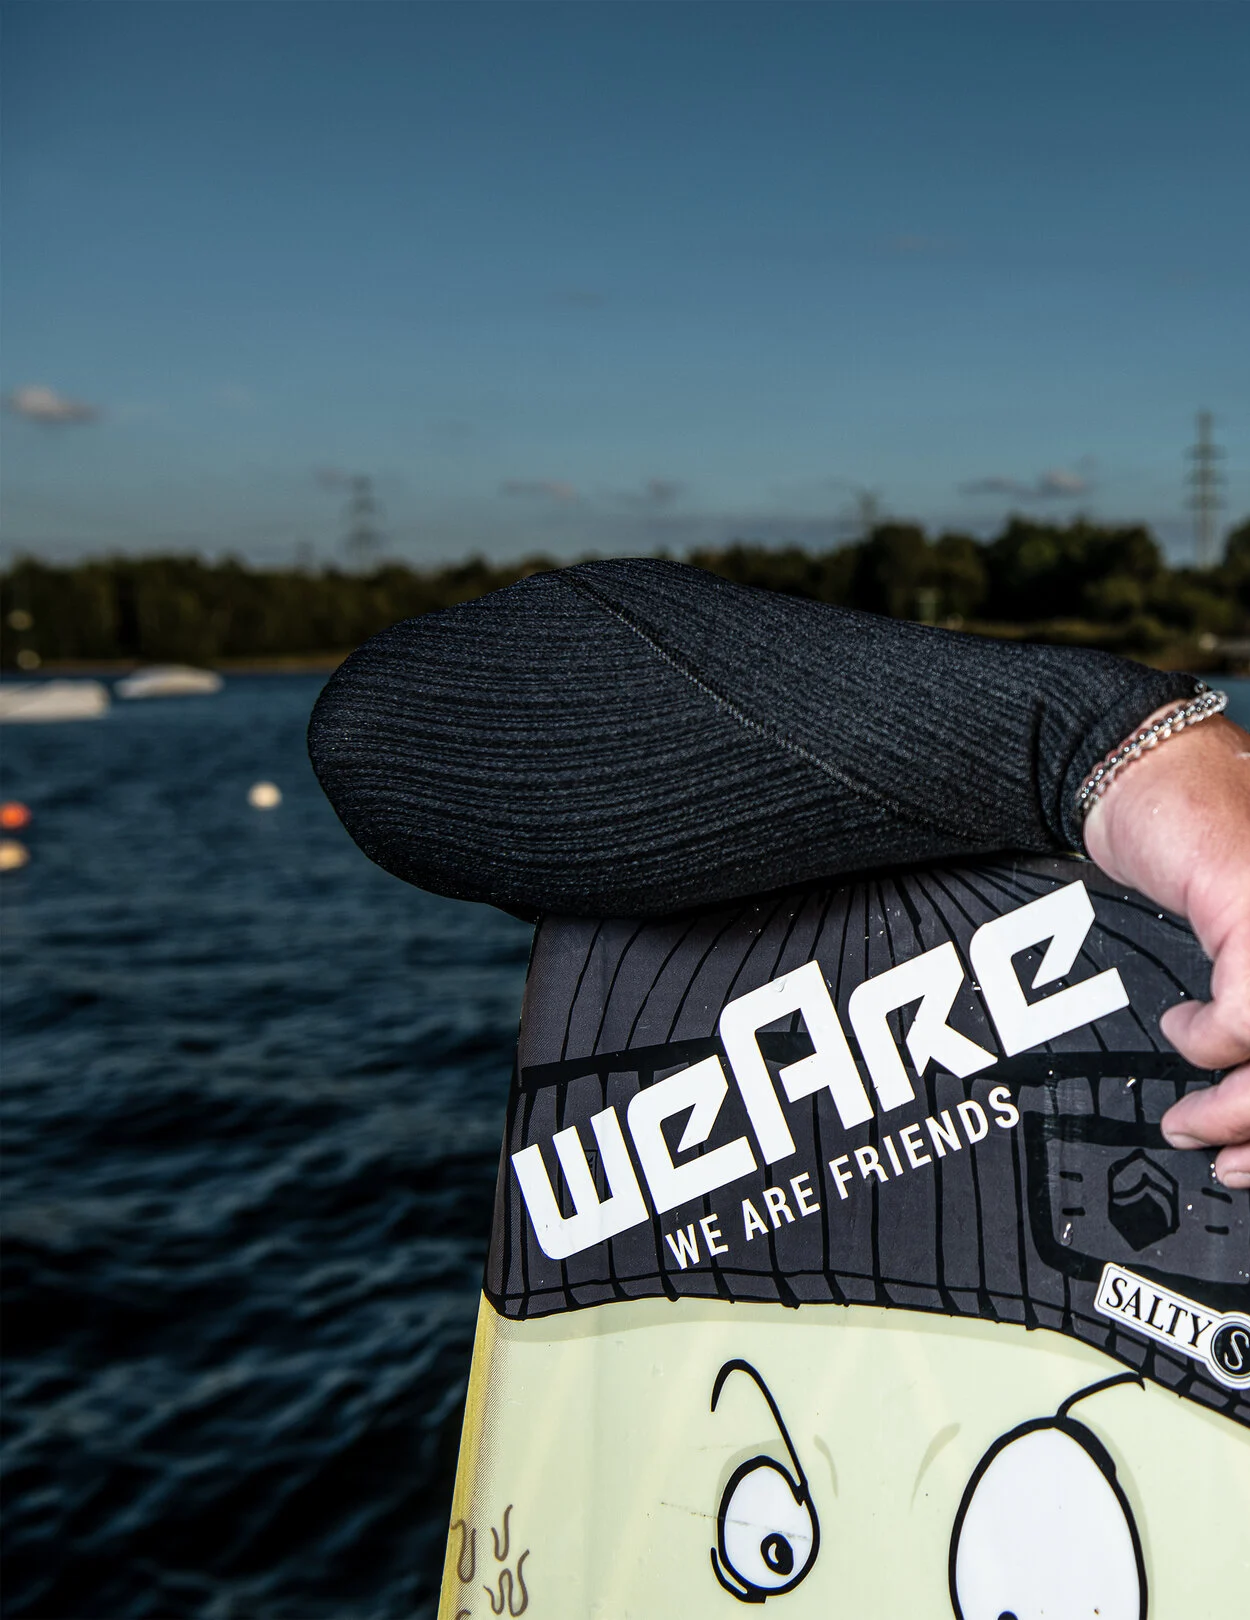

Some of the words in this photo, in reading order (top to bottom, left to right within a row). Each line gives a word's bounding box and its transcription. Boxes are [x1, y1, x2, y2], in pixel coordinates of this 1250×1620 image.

[664, 1213, 729, 1270] WE
[741, 1171, 821, 1241] ARE
[828, 1086, 1020, 1200] FRIENDS
[1105, 1277, 1213, 1349] SALTY
